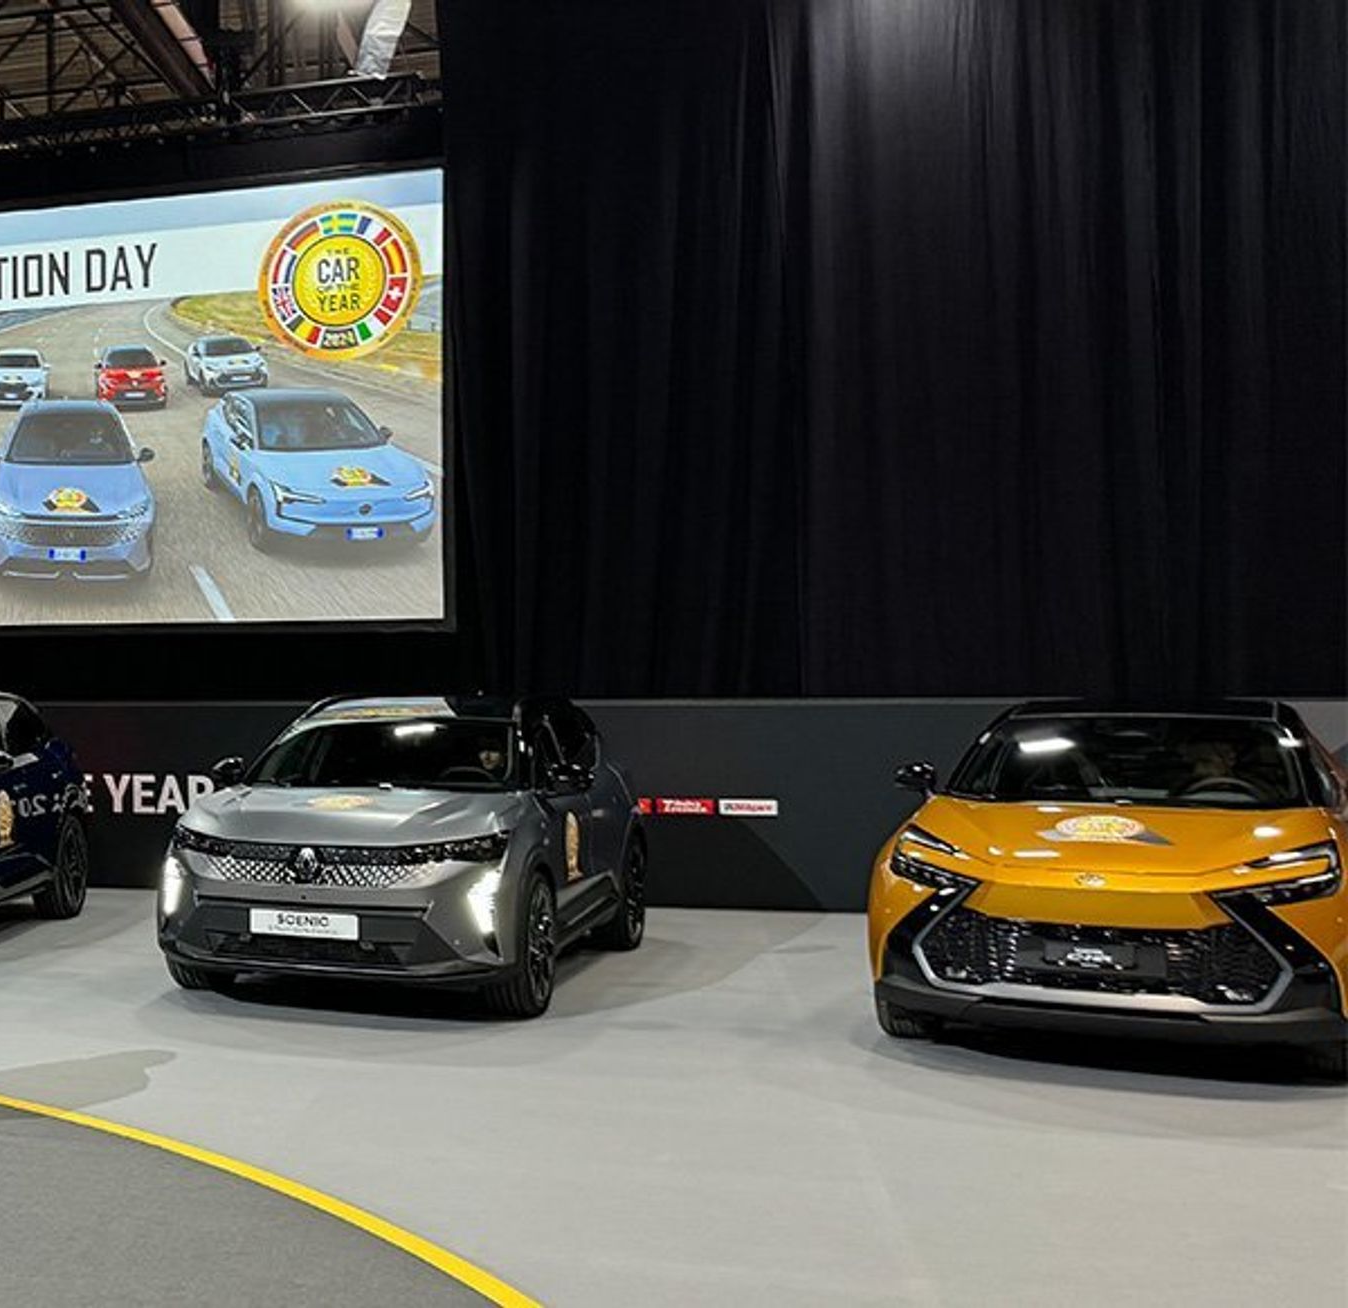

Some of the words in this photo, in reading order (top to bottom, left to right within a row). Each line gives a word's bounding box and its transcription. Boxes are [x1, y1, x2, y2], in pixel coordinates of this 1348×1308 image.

[85, 242, 157, 292] DAY
[317, 257, 360, 284] CAR
[317, 293, 361, 312] YEAR
[276, 912, 330, 927] SCENIC
